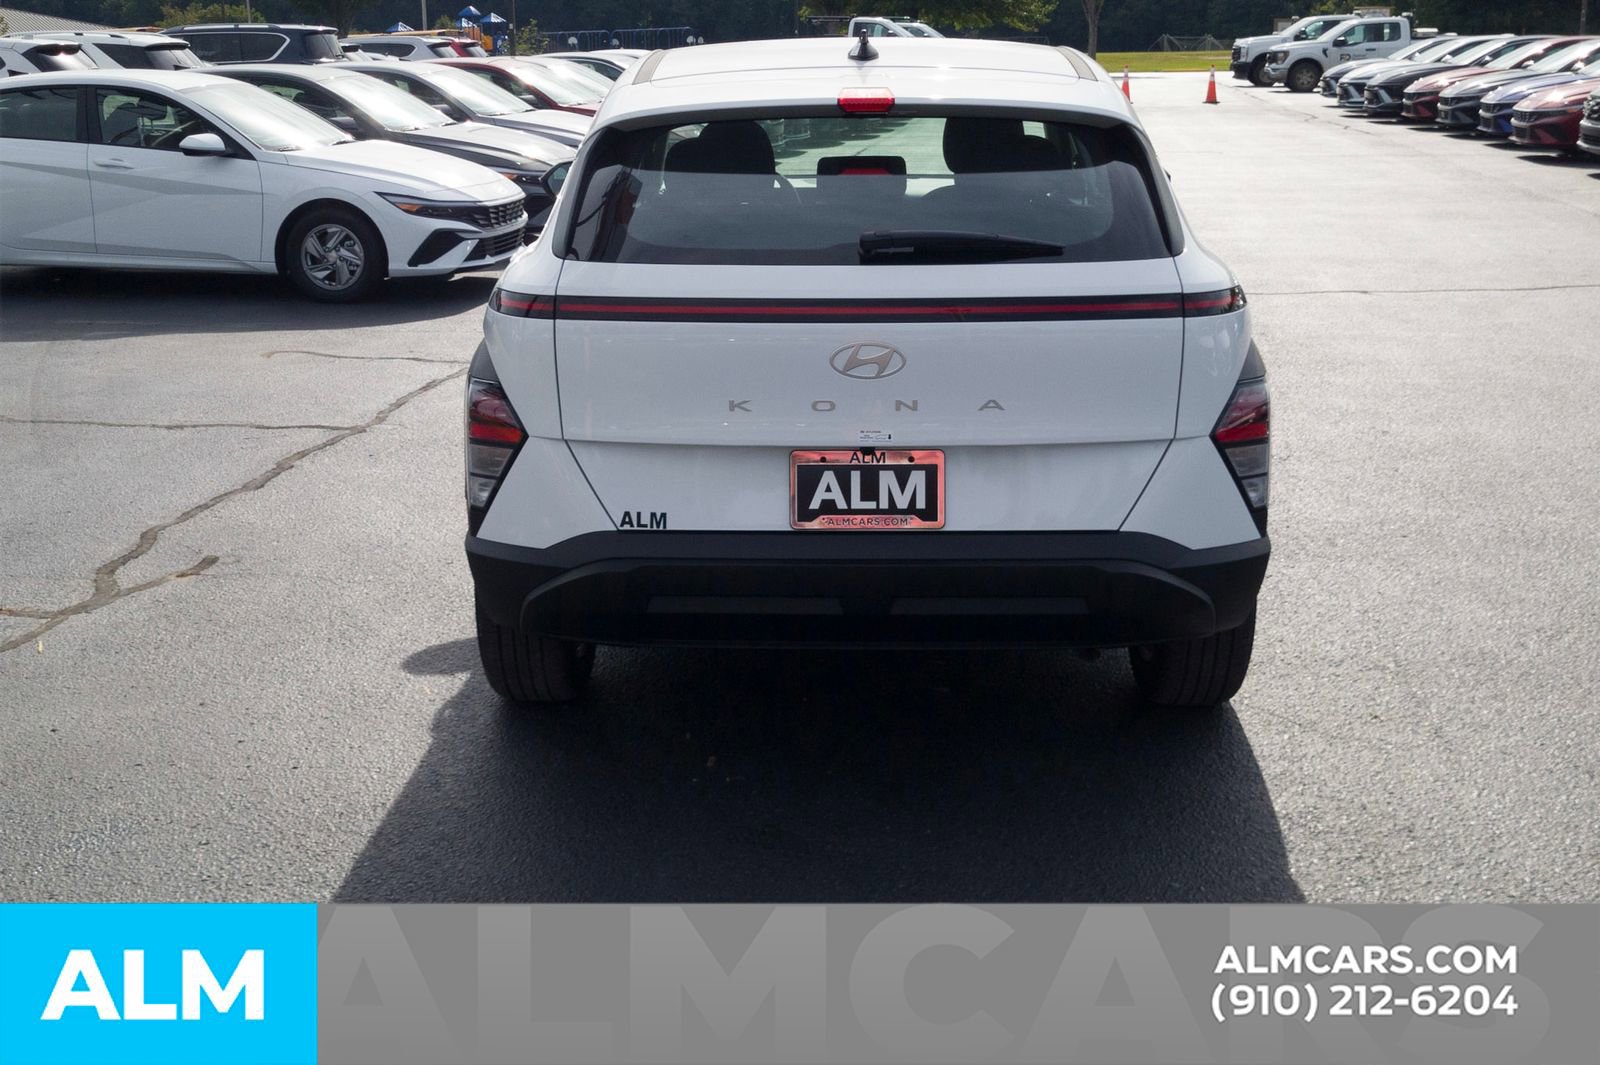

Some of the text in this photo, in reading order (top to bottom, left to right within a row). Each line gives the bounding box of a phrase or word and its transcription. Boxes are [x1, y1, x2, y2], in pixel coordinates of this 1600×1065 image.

[728, 399, 1005, 412] KONA
[850, 451, 886, 464] ALM
[808, 469, 926, 510] ALM
[619, 510, 668, 530] ALM
